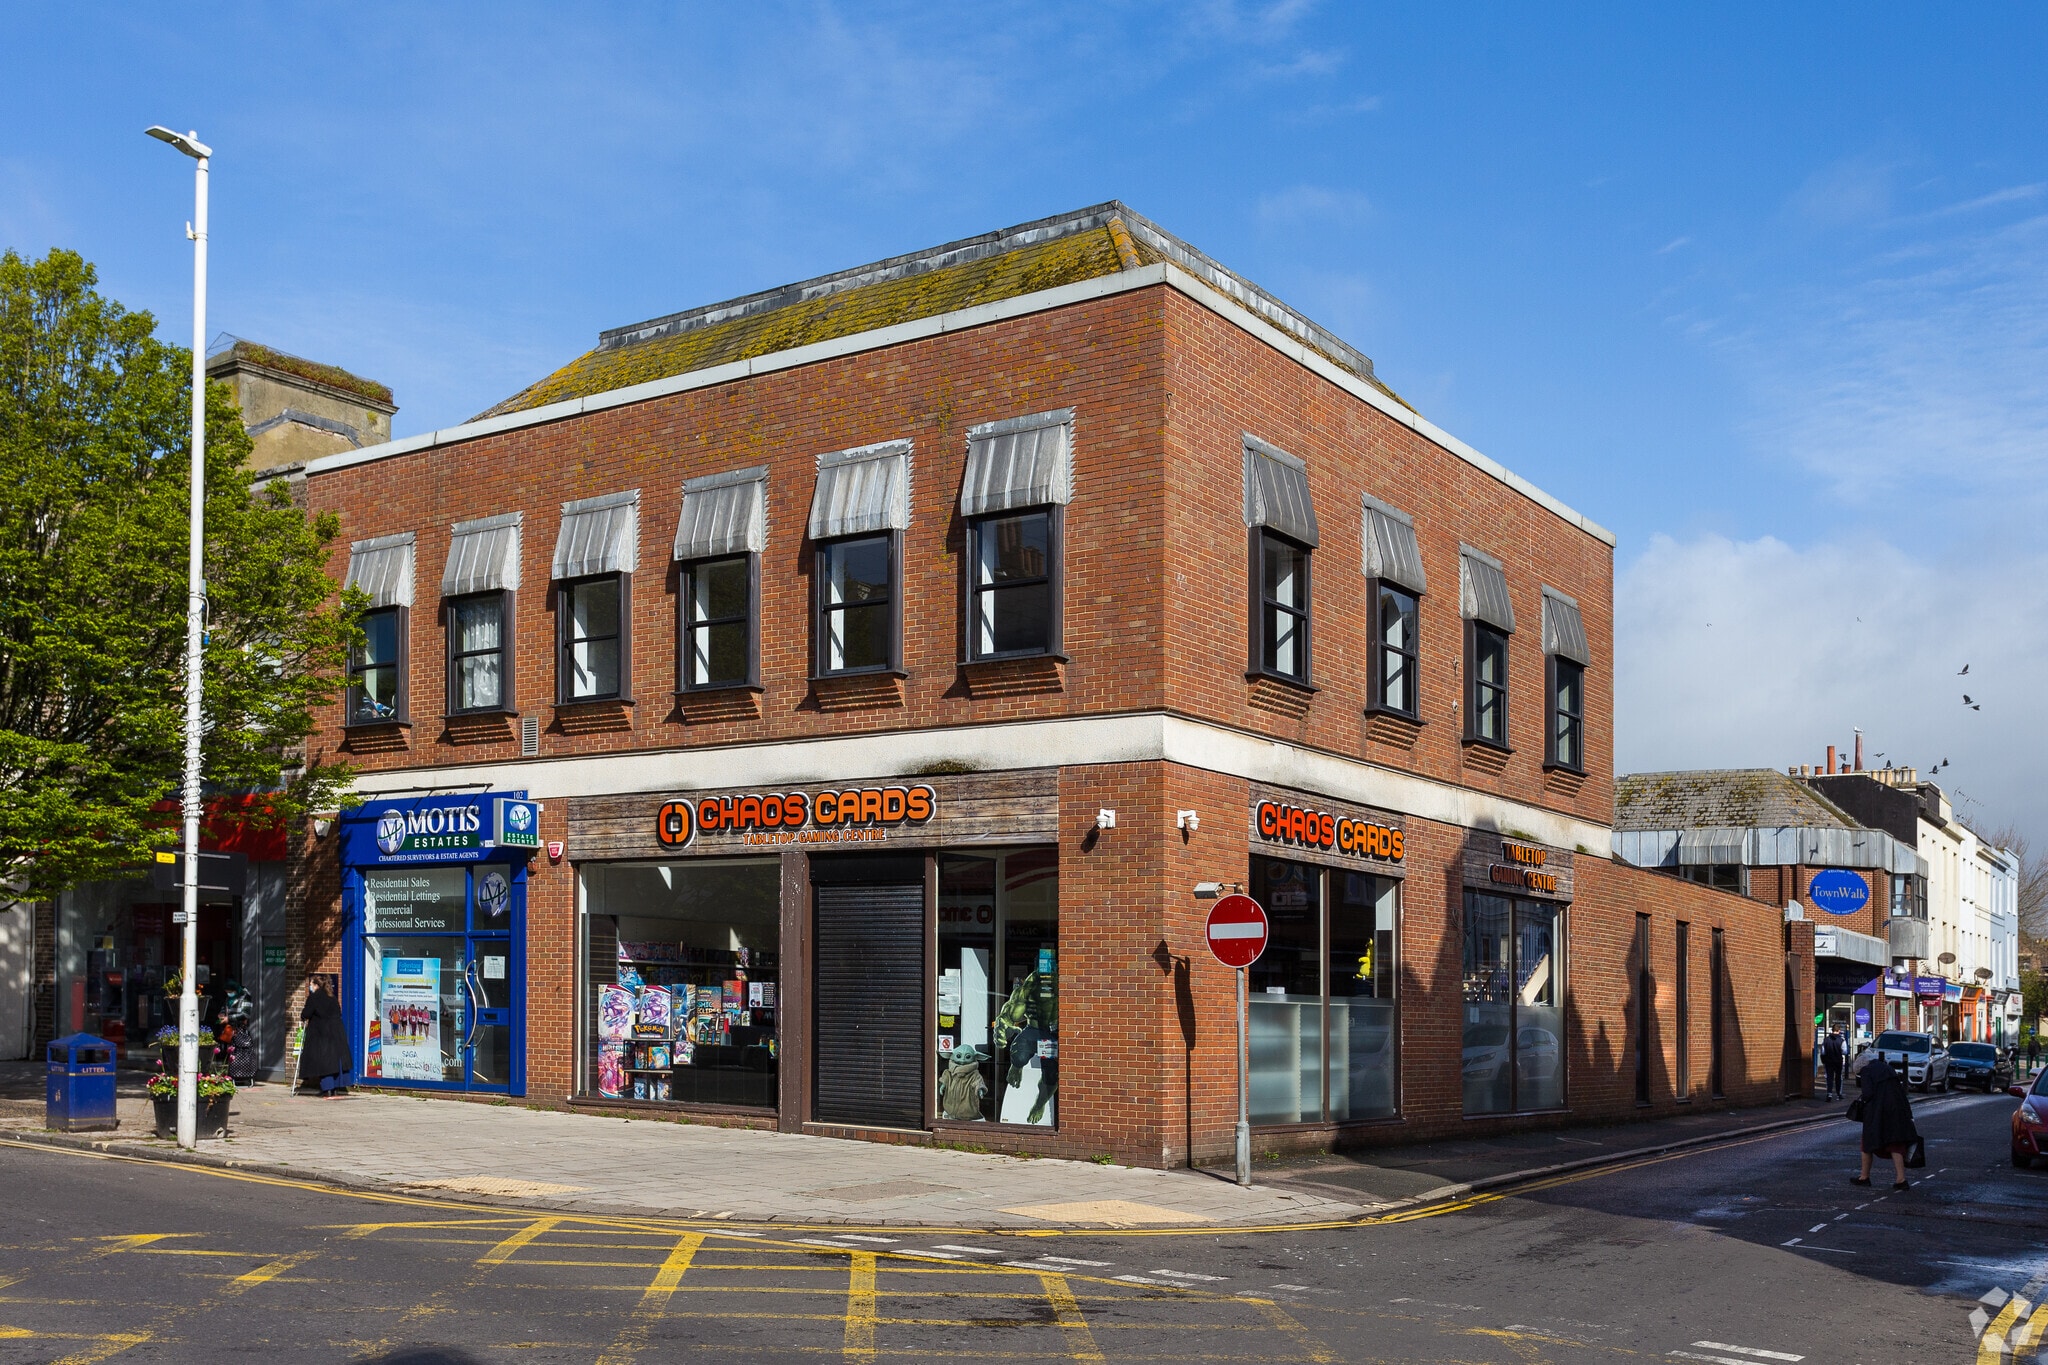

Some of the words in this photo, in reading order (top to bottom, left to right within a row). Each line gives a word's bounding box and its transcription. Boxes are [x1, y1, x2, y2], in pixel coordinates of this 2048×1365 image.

[513, 791, 524, 800] 102
[698, 791, 808, 832] CHAOS
[815, 785, 935, 828] CARDS
[407, 804, 480, 834] MOTIS
[743, 832, 796, 846] TABLETOP
[798, 830, 840, 844] GAMING
[842, 828, 887, 842] CENTRE
[1257, 801, 1335, 848] CHAOS
[1337, 816, 1406, 861] CARDS
[414, 836, 469, 848] ESTATES
[378, 854, 406, 862] CHARTERED
[406, 853, 435, 862] SURVEYORS
[440, 852, 458, 860] ESTATE
[458, 851, 479, 859] AGENTS
[1502, 842, 1547, 866] TABLETOP
[370, 878, 410, 889] Residential
[411, 877, 430, 888] Sales
[1489, 864, 1525, 887] GAMING
[1525, 870, 1557, 893] CENTRE
[370, 891, 410, 902] Residential
[411, 891, 441, 903] Lettings
[1814, 885, 1866, 899] TownWalk
[414, 917, 446, 928] Services
[401, 1050, 418, 1058] SAGA
